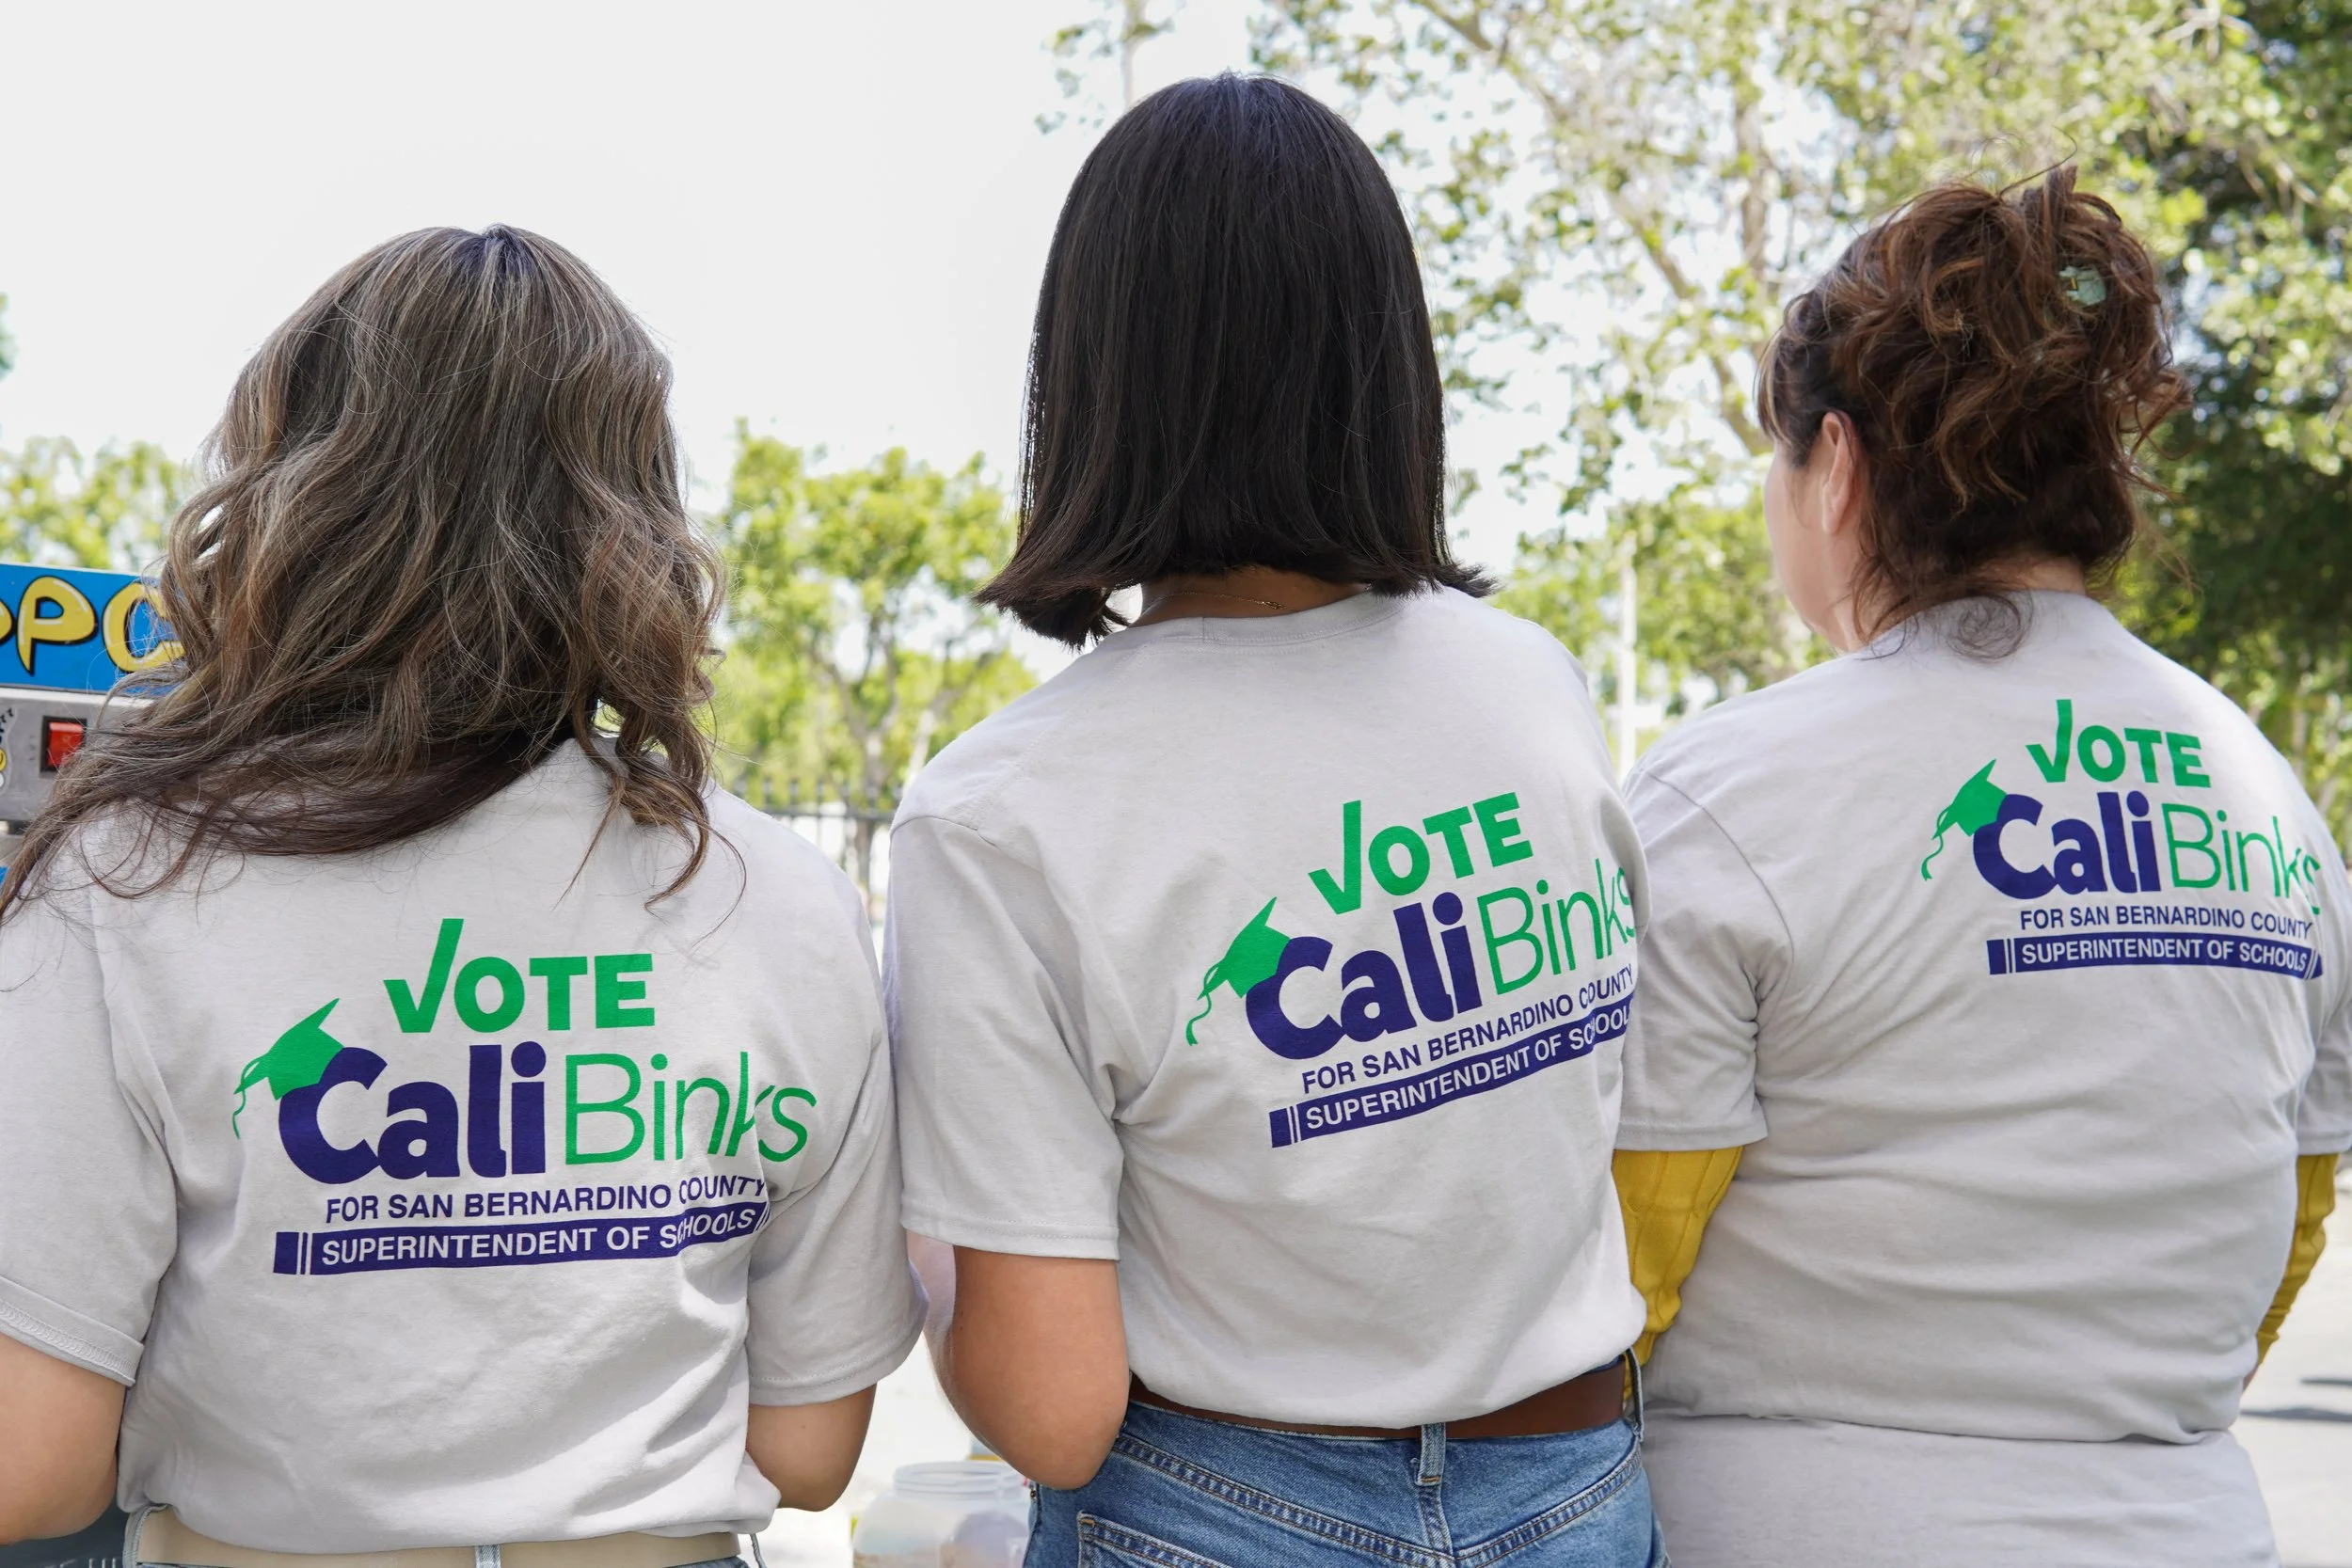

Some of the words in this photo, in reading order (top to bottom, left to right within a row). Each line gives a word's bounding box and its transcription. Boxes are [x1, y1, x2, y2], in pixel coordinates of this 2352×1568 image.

[2026, 700, 2210, 787] VOTE
[1309, 792, 1533, 914] VOTE
[1973, 791, 2160, 899] Cali
[2162, 803, 2319, 915] Binks
[384, 918, 655, 1033] VOTE
[1246, 892, 1483, 1060] Cali
[2021, 910, 2064, 929] FOR
[2071, 907, 2110, 927] SAN
[2117, 906, 2245, 928] BERNARDINO
[2251, 911, 2312, 940] COUNTY
[2022, 939, 2201, 963] SUPERINTENDENT
[2207, 942, 2233, 959] OF
[2240, 942, 2306, 972] SCHOOLS
[1302, 1062, 1355, 1094] FOR
[1363, 1049, 1421, 1079] SAN
[1429, 995, 1572, 1063] BERNARDINO
[1580, 964, 1633, 1007] COUNTY
[1307, 1047, 1531, 1130] SUPERINTENDENT
[1535, 1033, 1563, 1061] OF
[279, 1041, 546, 1184] Cali
[565, 1052, 817, 1164] Binks
[323, 1227, 606, 1265] SUPERINTENDENT
[612, 1225, 650, 1251] OF
[660, 1209, 755, 1247] SCHOOLS
[326, 1196, 379, 1223] FOR
[389, 1193, 453, 1217] SAN
[465, 1184, 670, 1215] BERNARDINO
[679, 1174, 767, 1203] COUNTY
